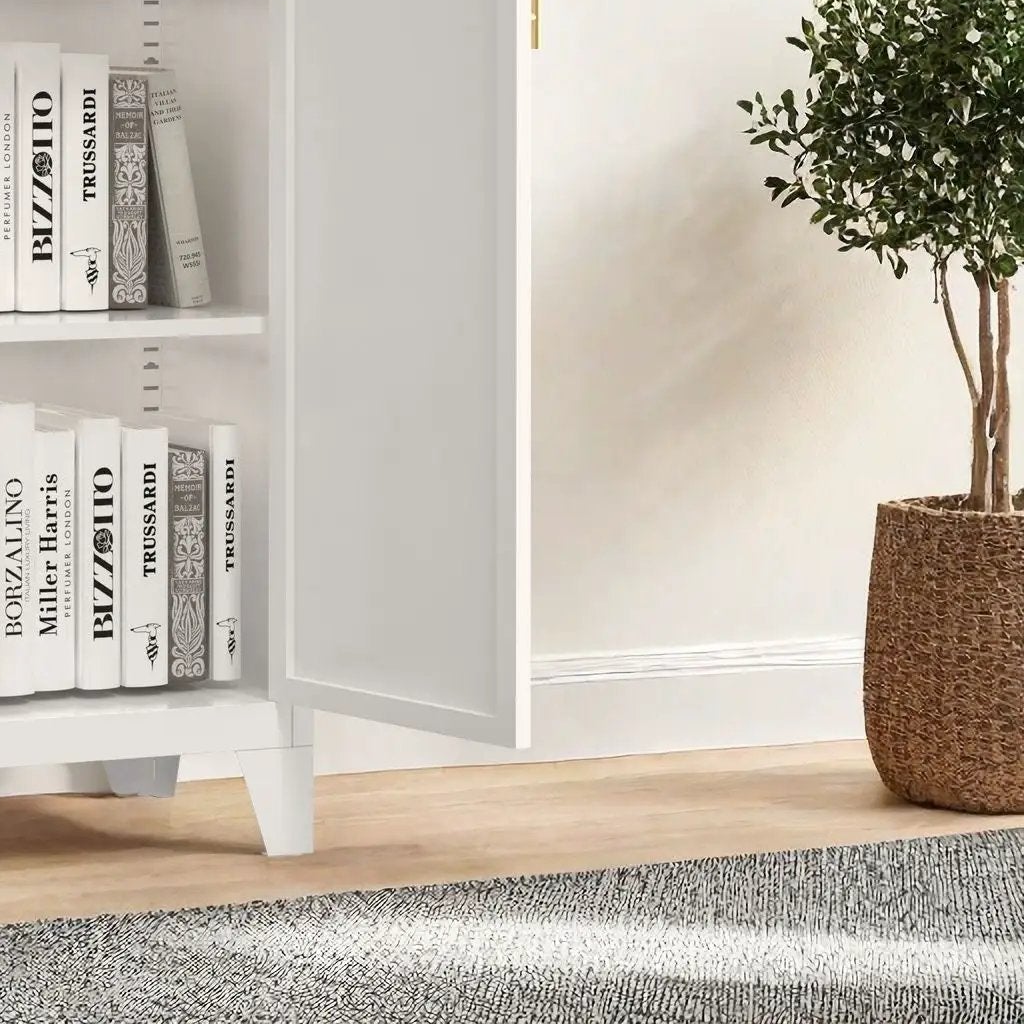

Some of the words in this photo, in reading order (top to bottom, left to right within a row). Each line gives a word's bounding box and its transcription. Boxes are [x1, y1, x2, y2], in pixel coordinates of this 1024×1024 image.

[83, 88, 97, 202] TRUSSARDI
[115, 111, 144, 119] MEMOIR
[39, 473, 58, 554] Harris
[64, 489, 72, 546] LONDON
[143, 463, 157, 578] TRUSSARDI
[174, 483, 202, 492] MEMOIR
[174, 504, 201, 512] BALZAC
[226, 459, 235, 573] TRUSSARDI
[5, 478, 23, 638] BORZALINO
[64, 553, 72, 618] PERFUMER
[39, 560, 58, 637] Miller
